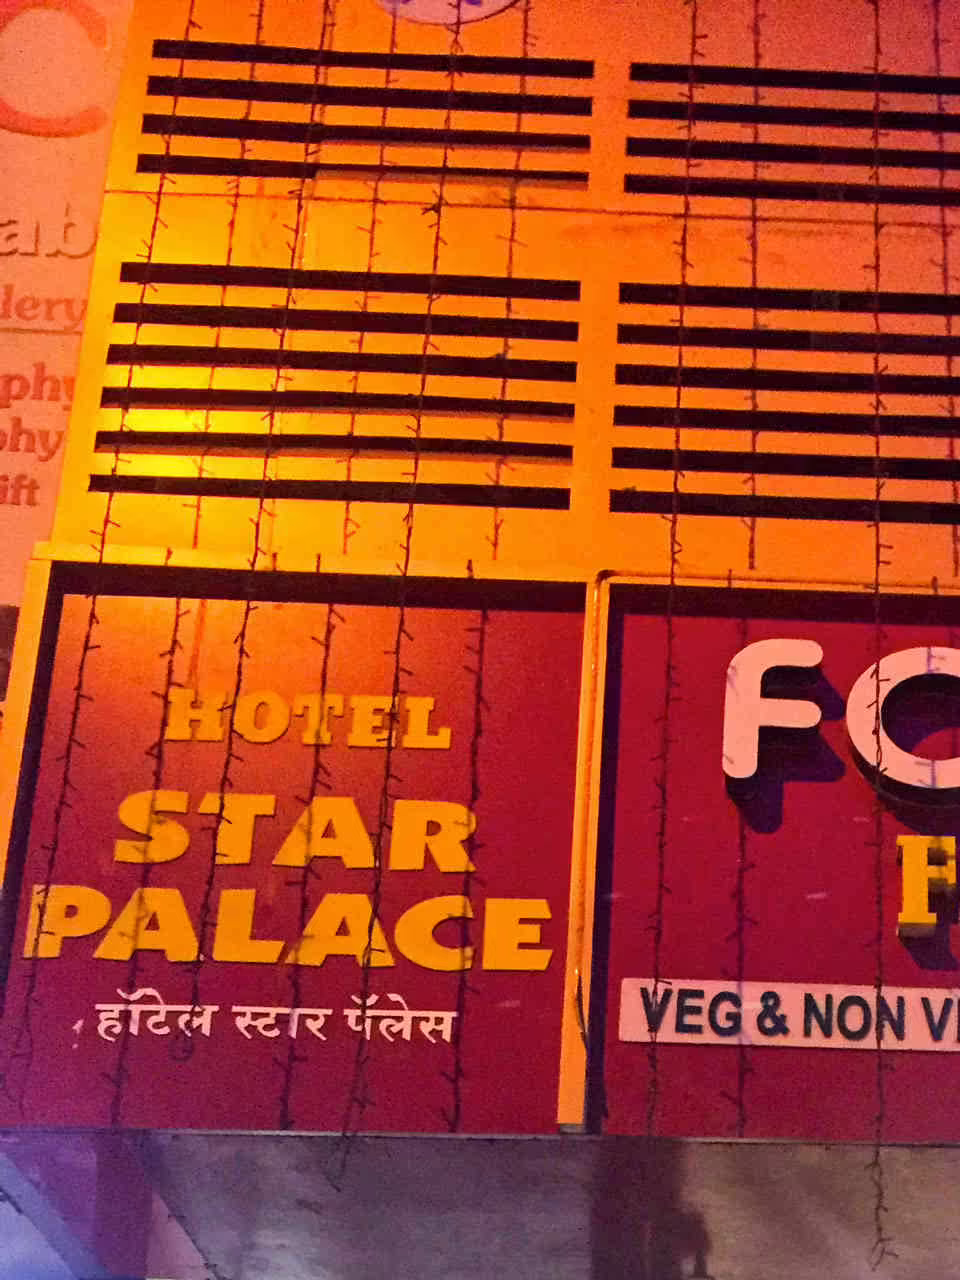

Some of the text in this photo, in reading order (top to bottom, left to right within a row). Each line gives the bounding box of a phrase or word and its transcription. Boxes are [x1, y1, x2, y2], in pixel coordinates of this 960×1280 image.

[164, 688, 452, 750] HOTEL
[113, 790, 477, 873] STAR
[23, 884, 553, 971] PALACE
[232, 1005, 332, 1041] स्टार
[641, 986, 743, 1037] VEG
[756, 989, 789, 1036] &
[803, 992, 905, 1042] NON
